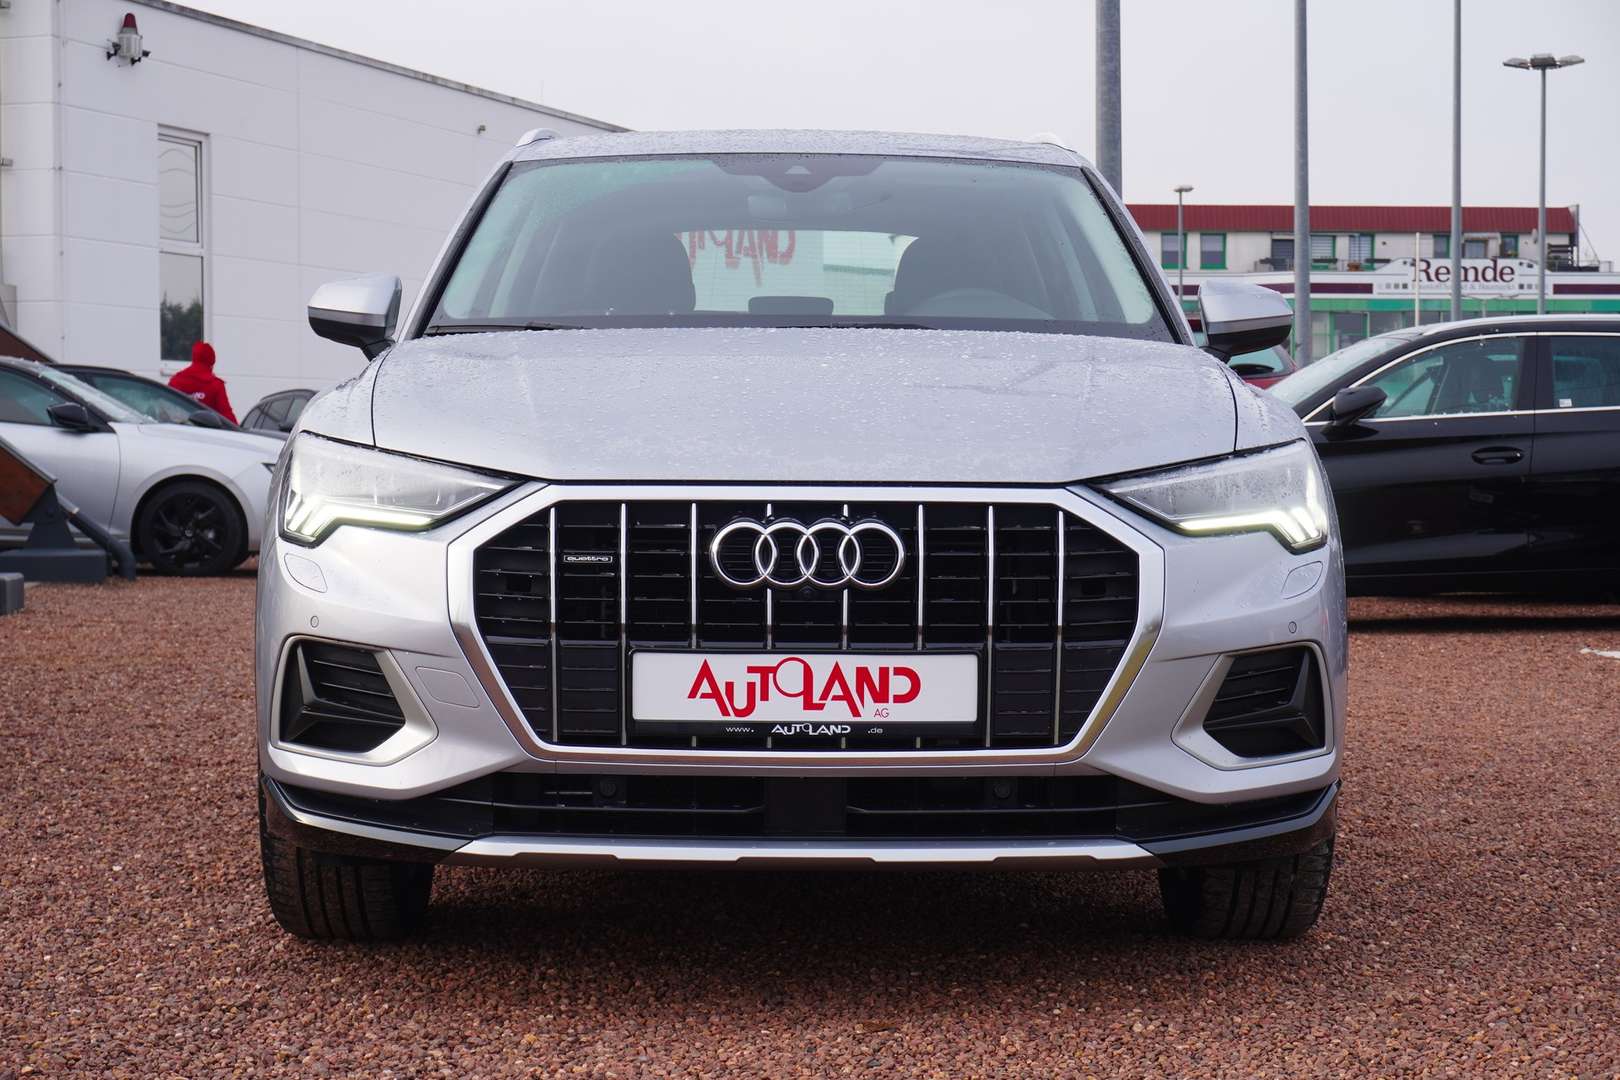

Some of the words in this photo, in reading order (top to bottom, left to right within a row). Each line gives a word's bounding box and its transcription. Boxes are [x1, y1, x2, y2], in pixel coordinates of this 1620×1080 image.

[688, 657, 921, 717] AUTOLAND
[874, 708, 889, 718] AG
[771, 723, 851, 735] AUTOLAND
